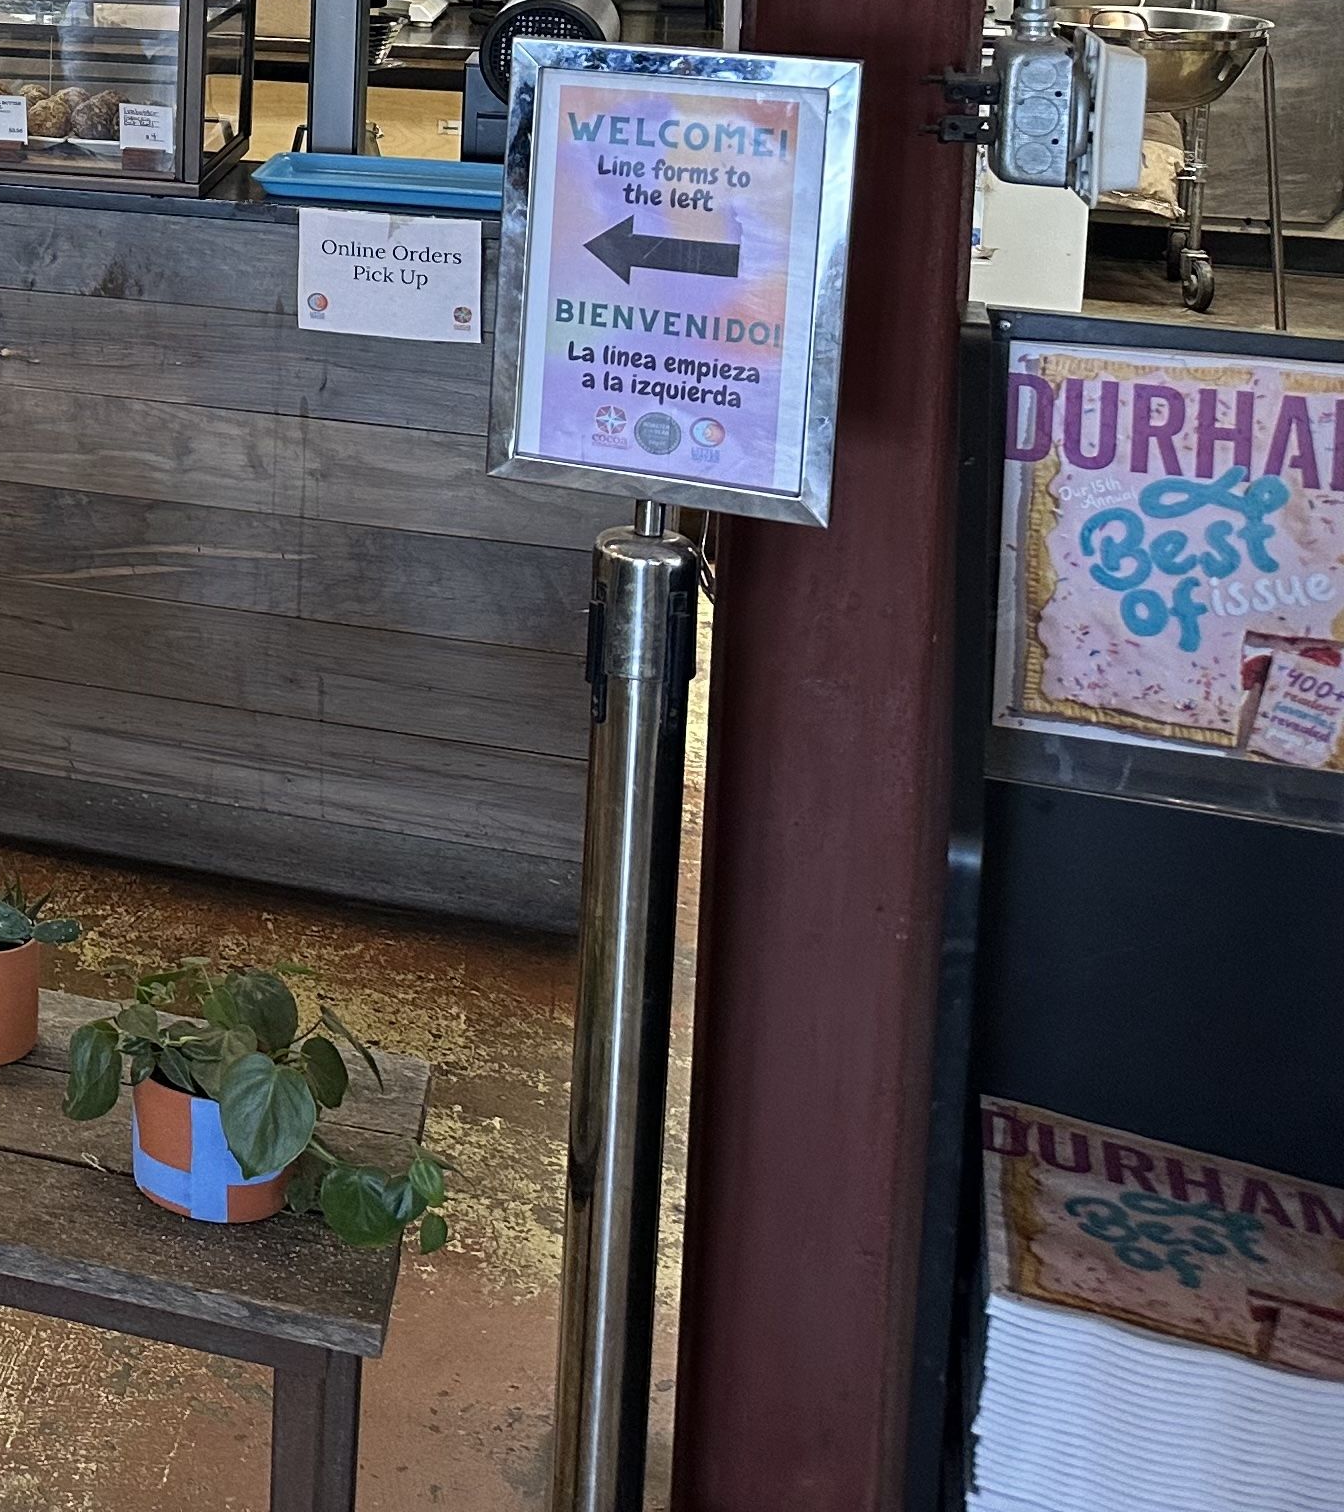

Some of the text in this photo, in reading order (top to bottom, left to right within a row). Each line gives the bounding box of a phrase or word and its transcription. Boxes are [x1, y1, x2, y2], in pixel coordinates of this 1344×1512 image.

[568, 112, 789, 160] WELCOME!
[597, 154, 751, 188] Line forms to
[623, 183, 714, 212] the left
[321, 239, 462, 265] Online Orders
[353, 265, 428, 289] Pick Up
[555, 298, 784, 348] BIENVENIDO!
[568, 341, 595, 364] La
[664, 355, 761, 384] empieza
[582, 371, 742, 409] a la izquierda
[1081, 488, 1138, 509] Annual
[1079, 465, 1291, 591] Best
[1210, 573, 1332, 617] issue
[1064, 1191, 1268, 1264] Best
